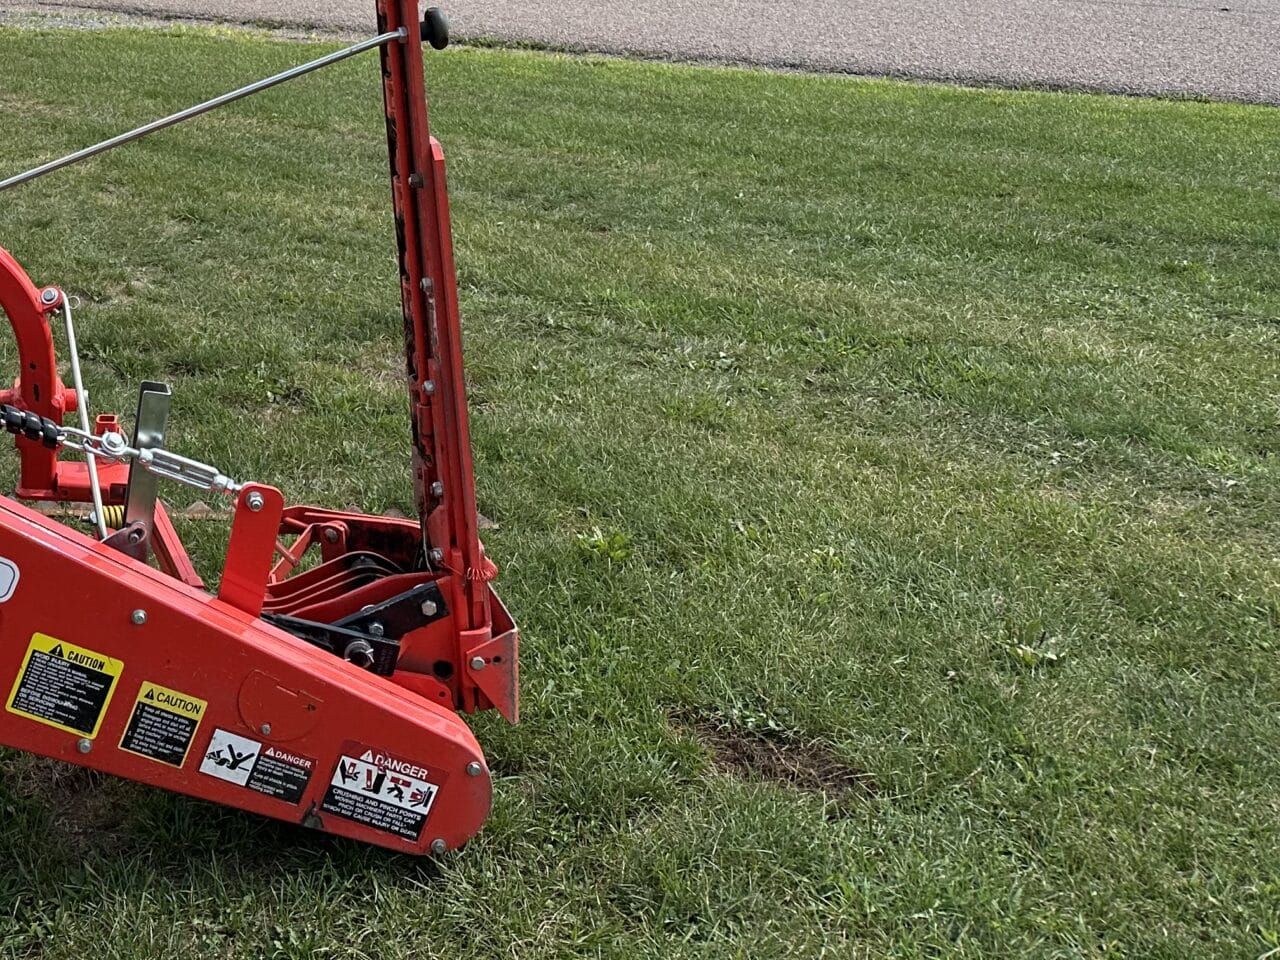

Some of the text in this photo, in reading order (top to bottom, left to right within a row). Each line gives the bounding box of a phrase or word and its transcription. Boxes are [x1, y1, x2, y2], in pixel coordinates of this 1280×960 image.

[66, 650, 105, 671] CAUTION
[155, 691, 201, 714] CAUTION
[274, 749, 311, 769] DANGER
[373, 754, 429, 779] DANGER
